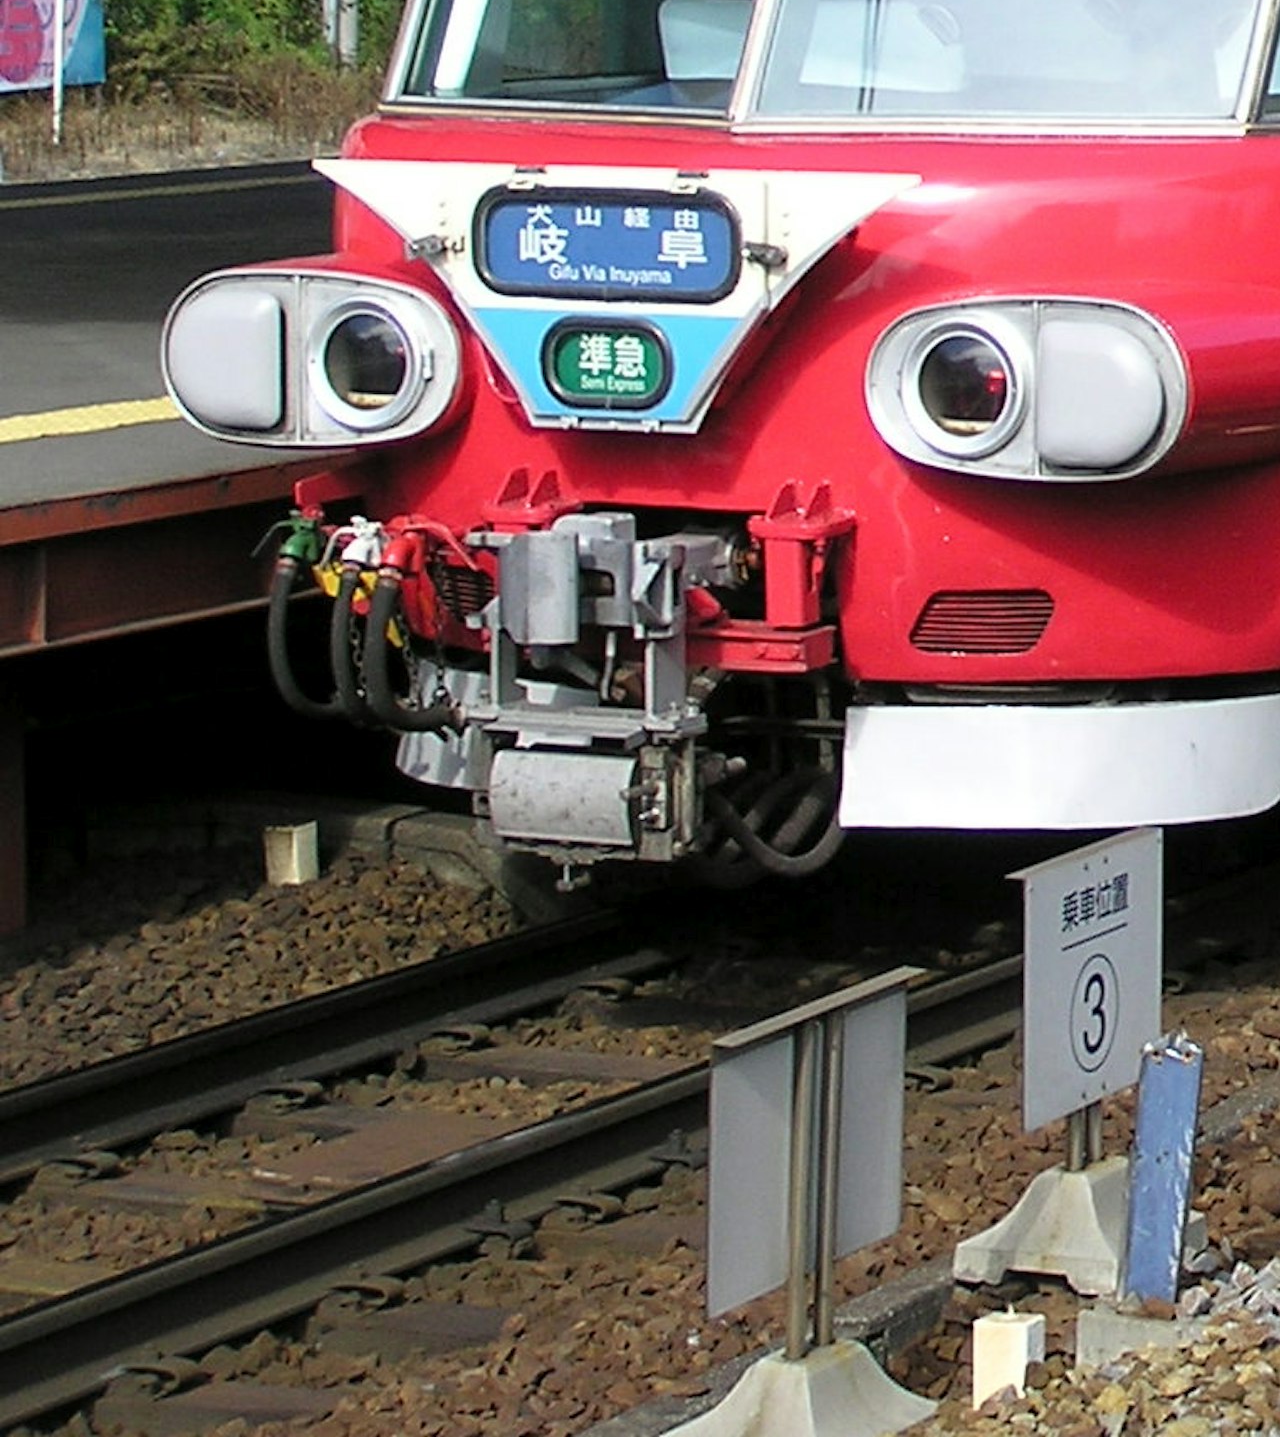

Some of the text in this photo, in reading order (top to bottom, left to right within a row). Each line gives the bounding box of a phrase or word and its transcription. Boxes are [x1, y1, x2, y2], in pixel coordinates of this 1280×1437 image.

[527, 205, 699, 229] 犬山経由
[518, 225, 708, 269] 岐阜
[549, 263, 672, 287] Gifu Via Inuyama
[579, 333, 647, 378] 準急
[1061, 872, 1129, 933] 乗車位置
